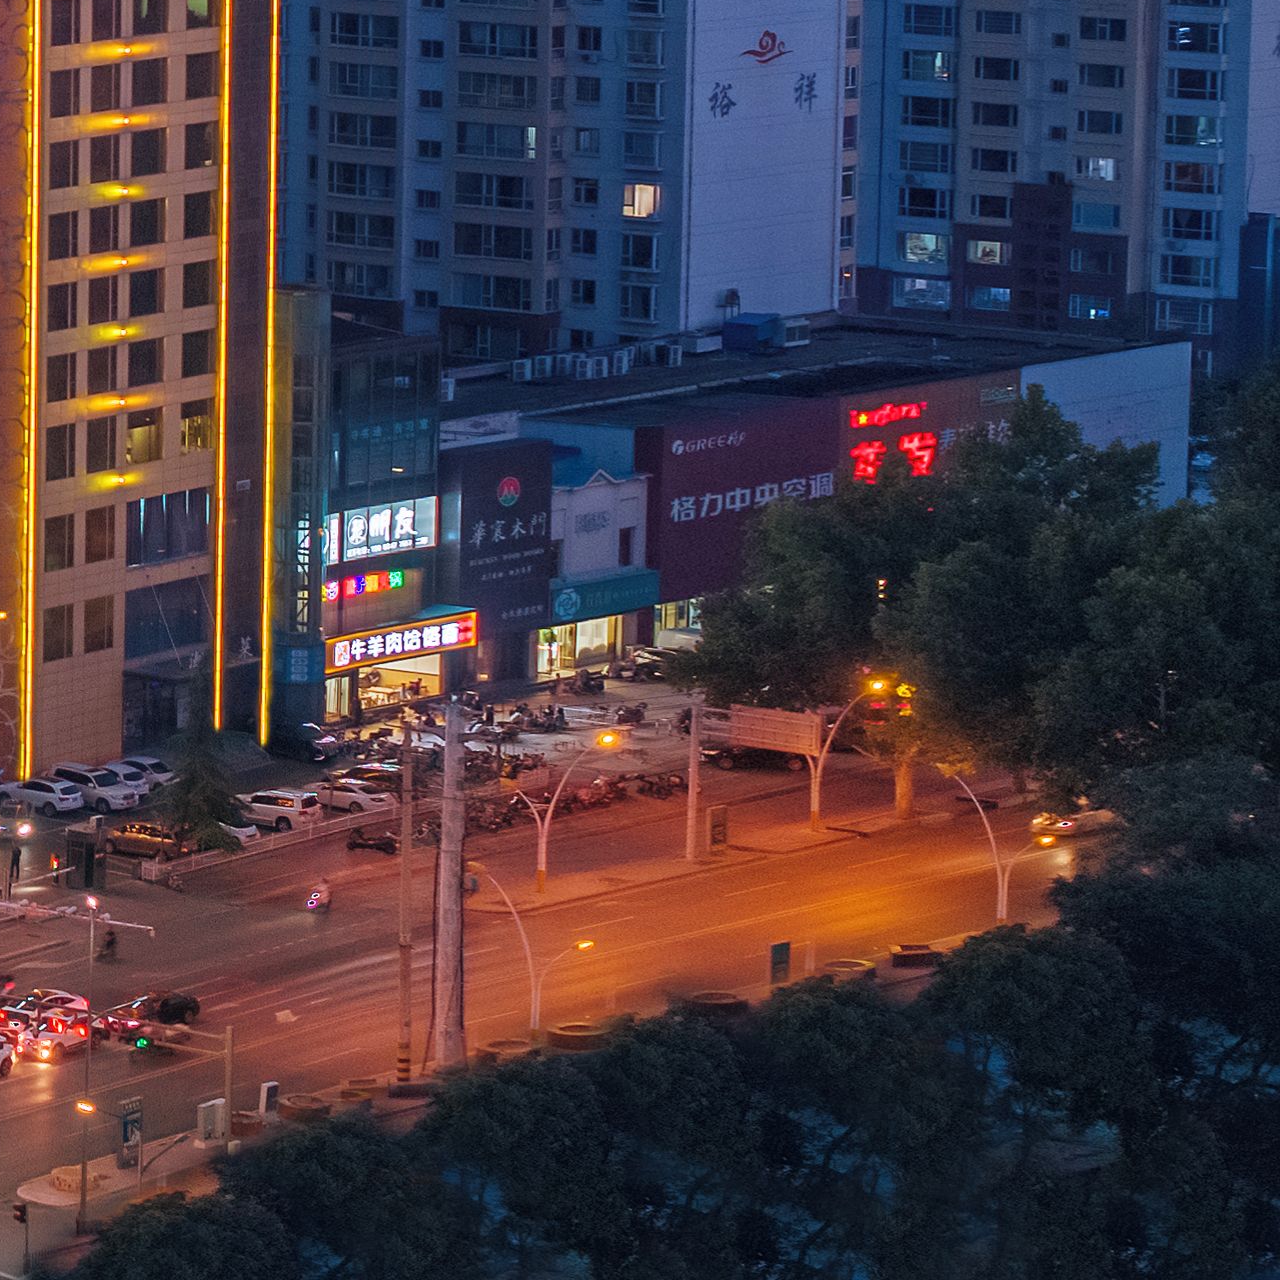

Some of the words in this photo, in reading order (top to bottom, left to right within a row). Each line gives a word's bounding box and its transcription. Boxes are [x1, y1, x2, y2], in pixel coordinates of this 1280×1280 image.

[685, 434, 727, 453] GREE
[670, 472, 834, 523] 格力中央空调
